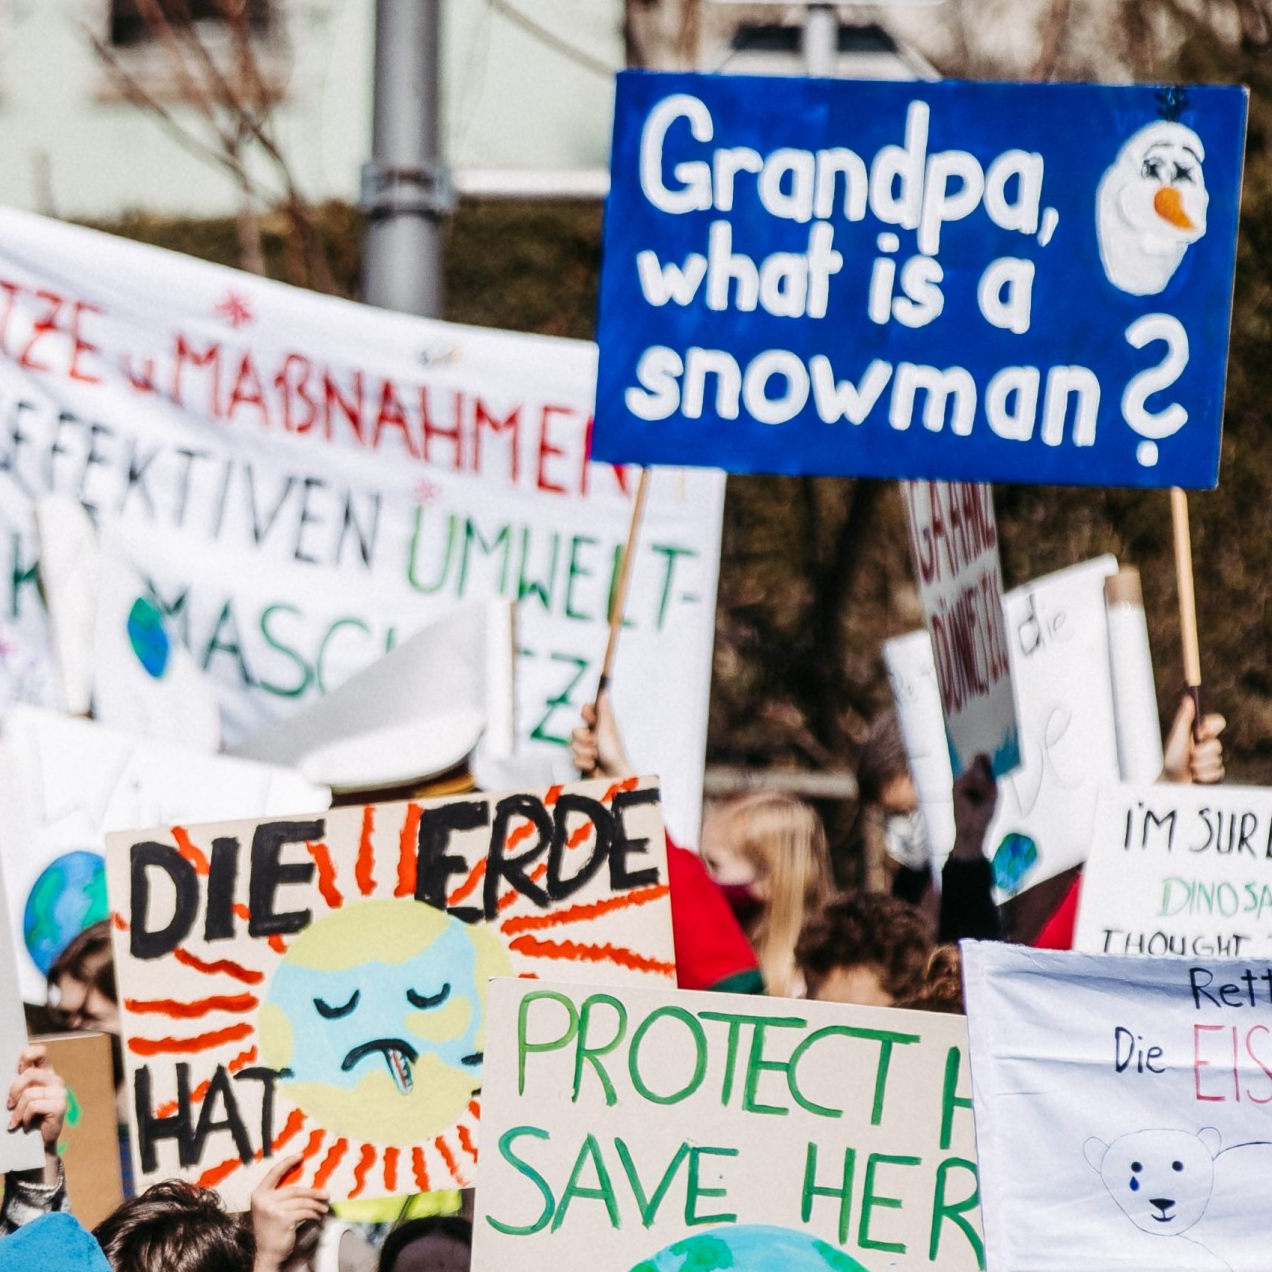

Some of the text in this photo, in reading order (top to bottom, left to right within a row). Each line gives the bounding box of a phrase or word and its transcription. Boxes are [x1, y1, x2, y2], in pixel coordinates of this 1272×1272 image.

[639, 93, 1059, 257] Grandpa,
[635, 219, 1036, 335] what is a
[128, 788, 661, 960] DIE ERDE
[1124, 802, 1272, 858] I'M SUR
[1102, 929, 1251, 957] THOUGHT
[516, 989, 921, 1127] PROTECT
[1114, 1026, 1166, 1074] Die
[132, 1061, 296, 1174] HAT
[485, 1124, 986, 1272] SAVE HER
